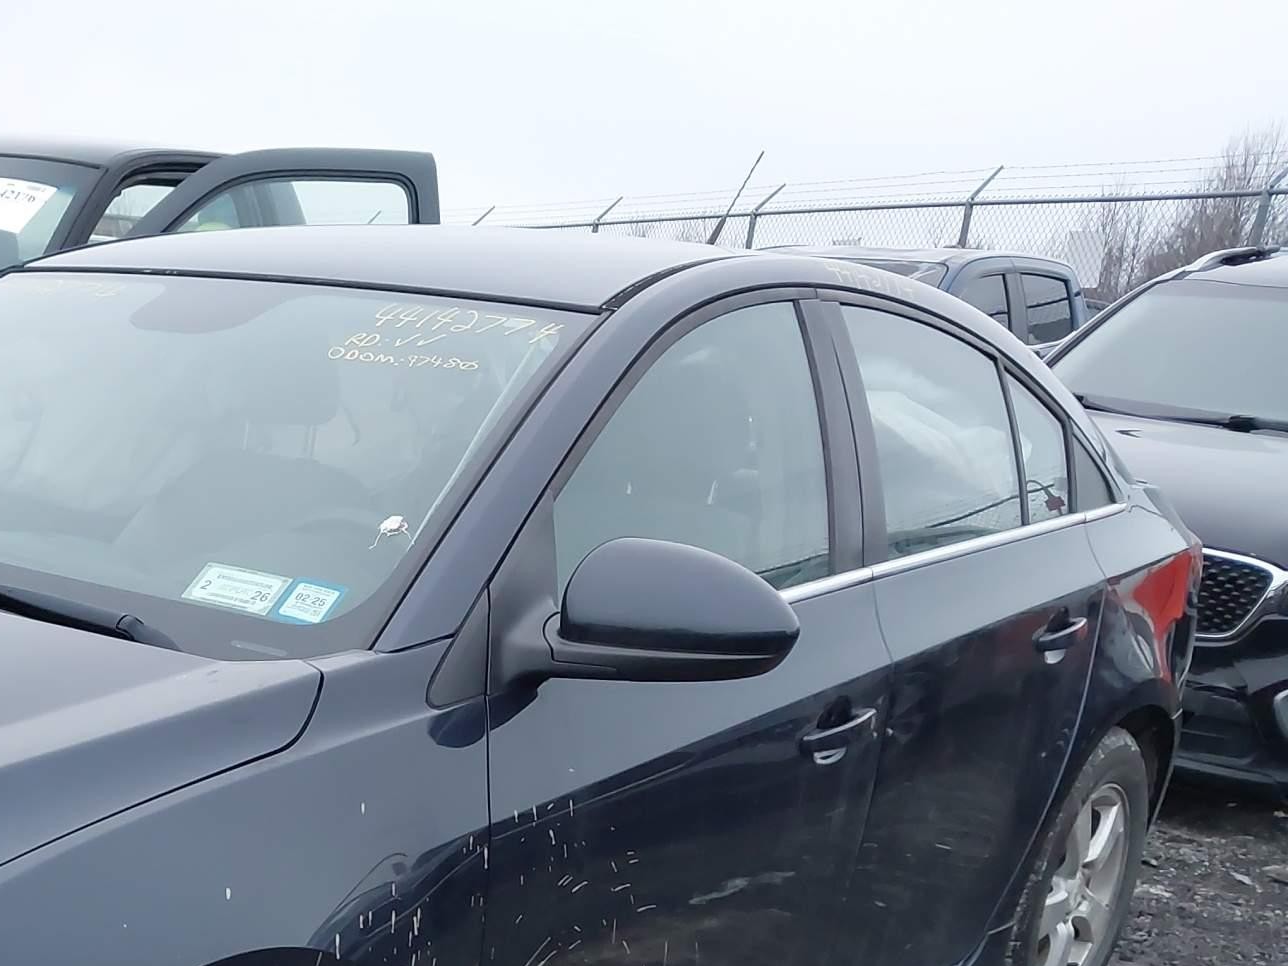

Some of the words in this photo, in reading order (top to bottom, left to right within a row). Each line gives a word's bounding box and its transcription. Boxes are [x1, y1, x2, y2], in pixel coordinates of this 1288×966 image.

[374, 302, 565, 344] 44142774
[199, 579, 212, 590] 2
[250, 590, 272, 603] 26
